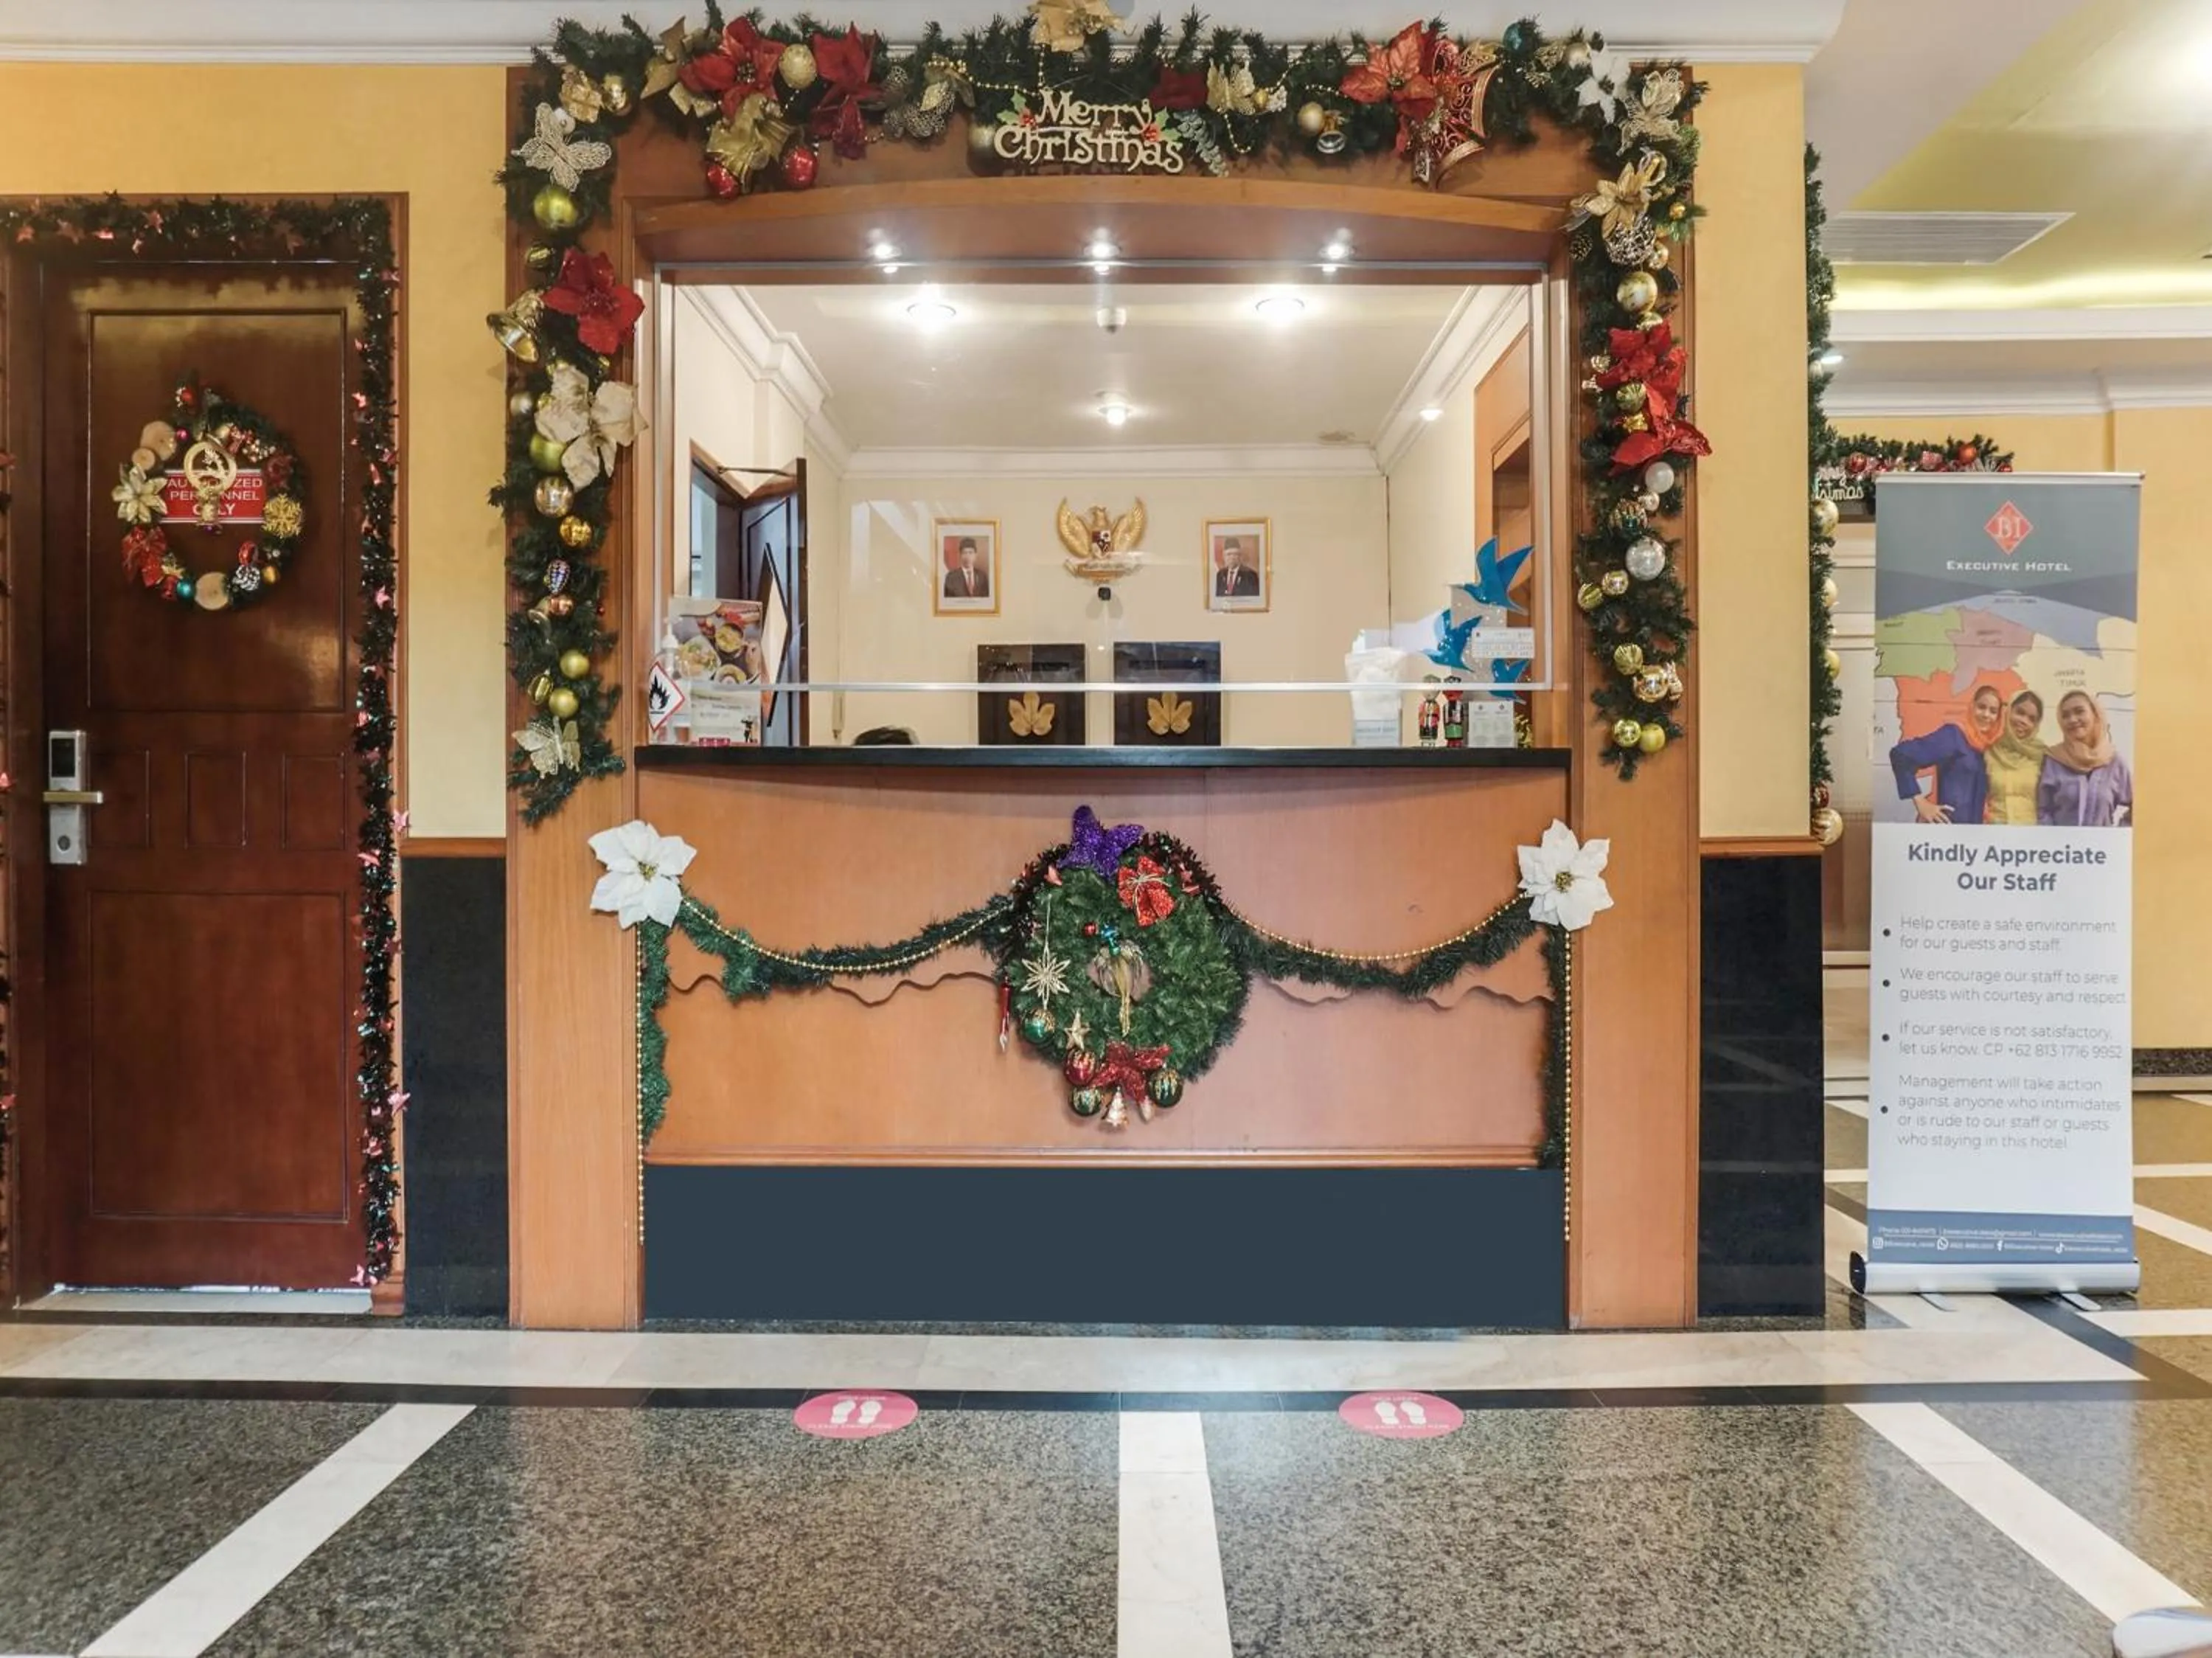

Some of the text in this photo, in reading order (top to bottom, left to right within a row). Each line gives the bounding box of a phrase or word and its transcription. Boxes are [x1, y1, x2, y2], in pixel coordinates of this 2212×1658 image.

[1036, 87, 1152, 135] Merry
[995, 124, 1183, 173] Christmas
[192, 503, 235, 516] OLY
[1997, 516, 2021, 538] BI
[1947, 561, 2073, 572] EXECUTIVE HOTEL
[1908, 842, 2107, 867] Kindly Appreciate
[1958, 873, 2057, 891] Our Staff
[1900, 916, 2117, 933] Help create a safe environment
[1900, 935, 1919, 948] for
[1923, 938, 1946, 949] our
[1950, 938, 1995, 952] guests
[1998, 938, 2025, 951] and
[1900, 968, 2118, 984] We encourage our staff to serve
[1900, 988, 1946, 1002] guests
[1950, 988, 1980, 1001] with
[1983, 990, 2042, 1004] courtesy
[2045, 991, 2074, 1002] and
[1900, 1019, 1910, 1033] If
[1913, 1024, 1934, 1035] our
[1939, 1023, 1986, 1036] service
[1990, 1025, 2000, 1036] is
[2004, 1026, 2026, 1036] not
[1899, 1041, 1916, 1055] let
[1921, 1044, 1936, 1055] us
[2008, 1044, 2031, 1057] +62
[2035, 1044, 2057, 1057] 813
[2062, 1044, 2089, 1058] 1716
[1899, 1075, 2102, 1091] Management will take action
[1899, 1096, 2121, 1111] against anyone who intimidates
[1897, 1114, 2110, 1131] or is rude to our staff or guests
[1897, 1133, 1927, 1145] who
[1932, 1134, 1981, 1149] staying
[1986, 1136, 1997, 1146] in
[2001, 1135, 2027, 1148] this
